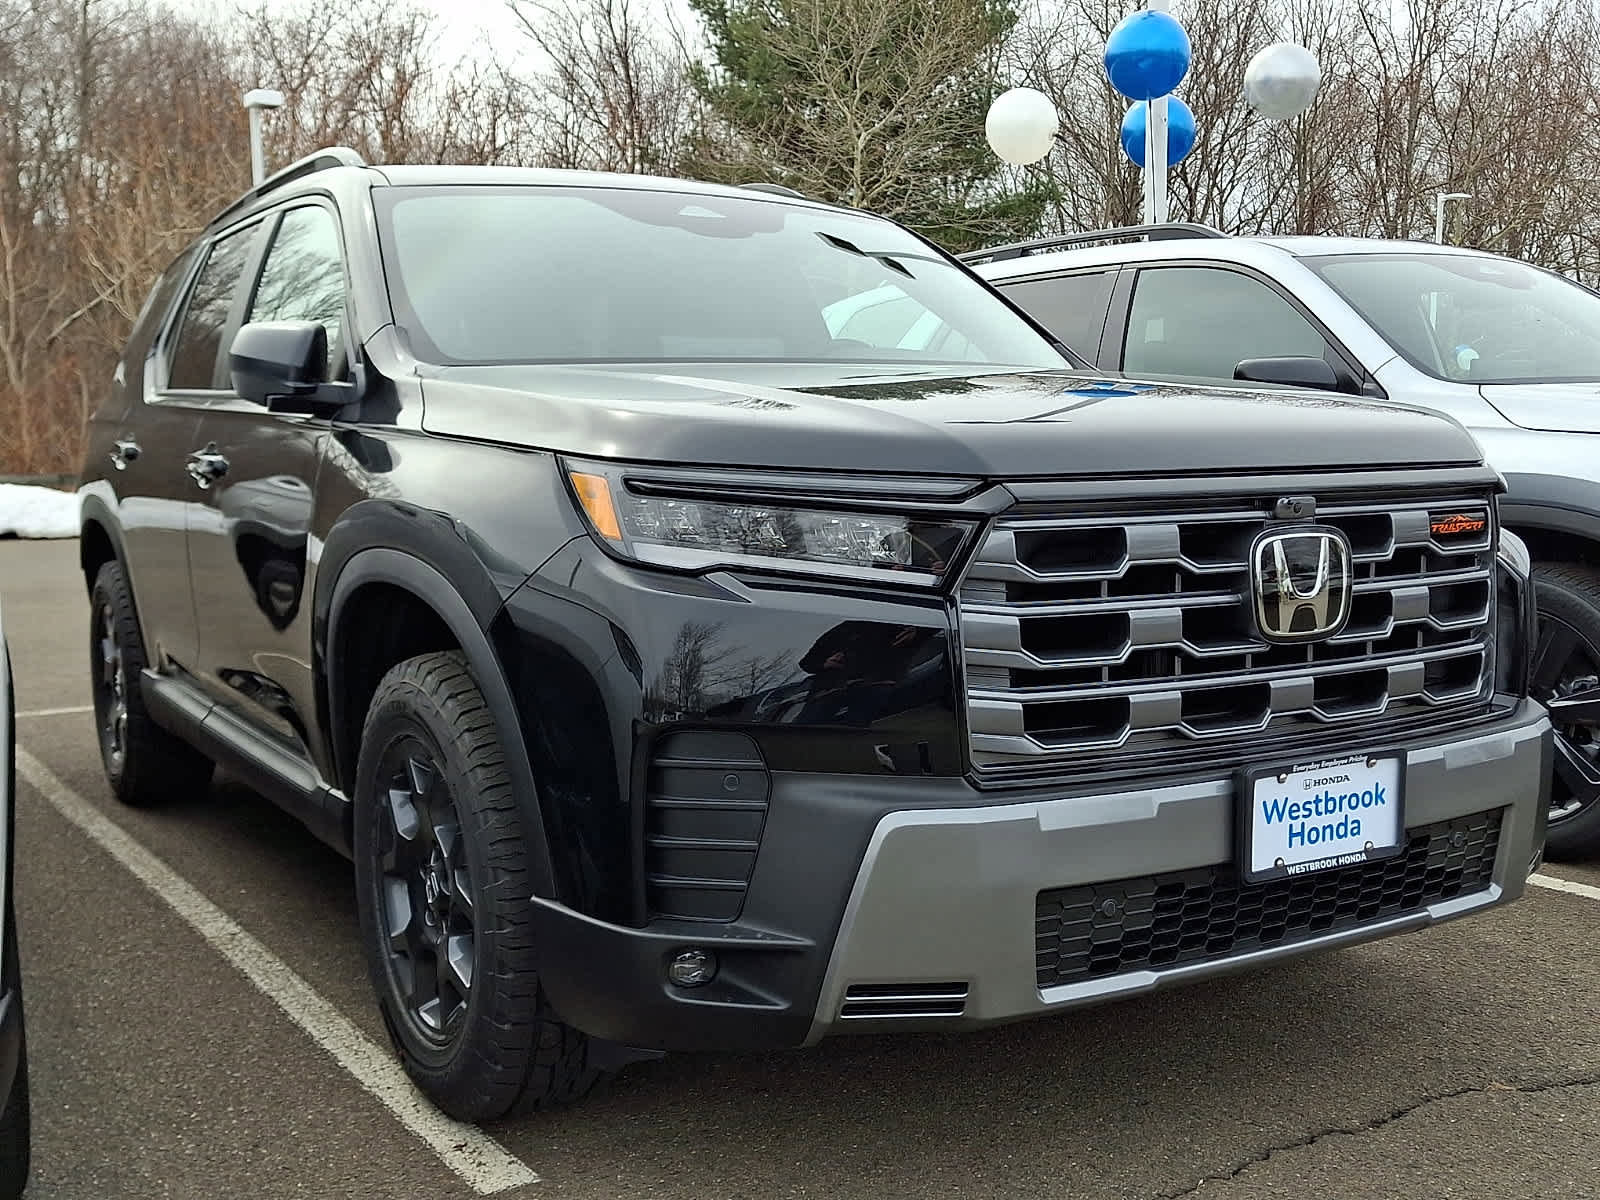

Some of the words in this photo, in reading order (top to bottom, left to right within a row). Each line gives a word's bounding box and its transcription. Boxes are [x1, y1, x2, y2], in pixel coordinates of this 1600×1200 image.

[1431, 521, 1484, 533] TRAILSPORT
[1293, 763, 1320, 773] Everyday
[1321, 758, 1348, 769] Employee
[1313, 775, 1350, 786] HONDA
[1262, 782, 1386, 824] Westbrook
[1288, 814, 1361, 848] Honda
[1287, 858, 1337, 875] WESTBROOK
[1338, 852, 1367, 865] HONDA
